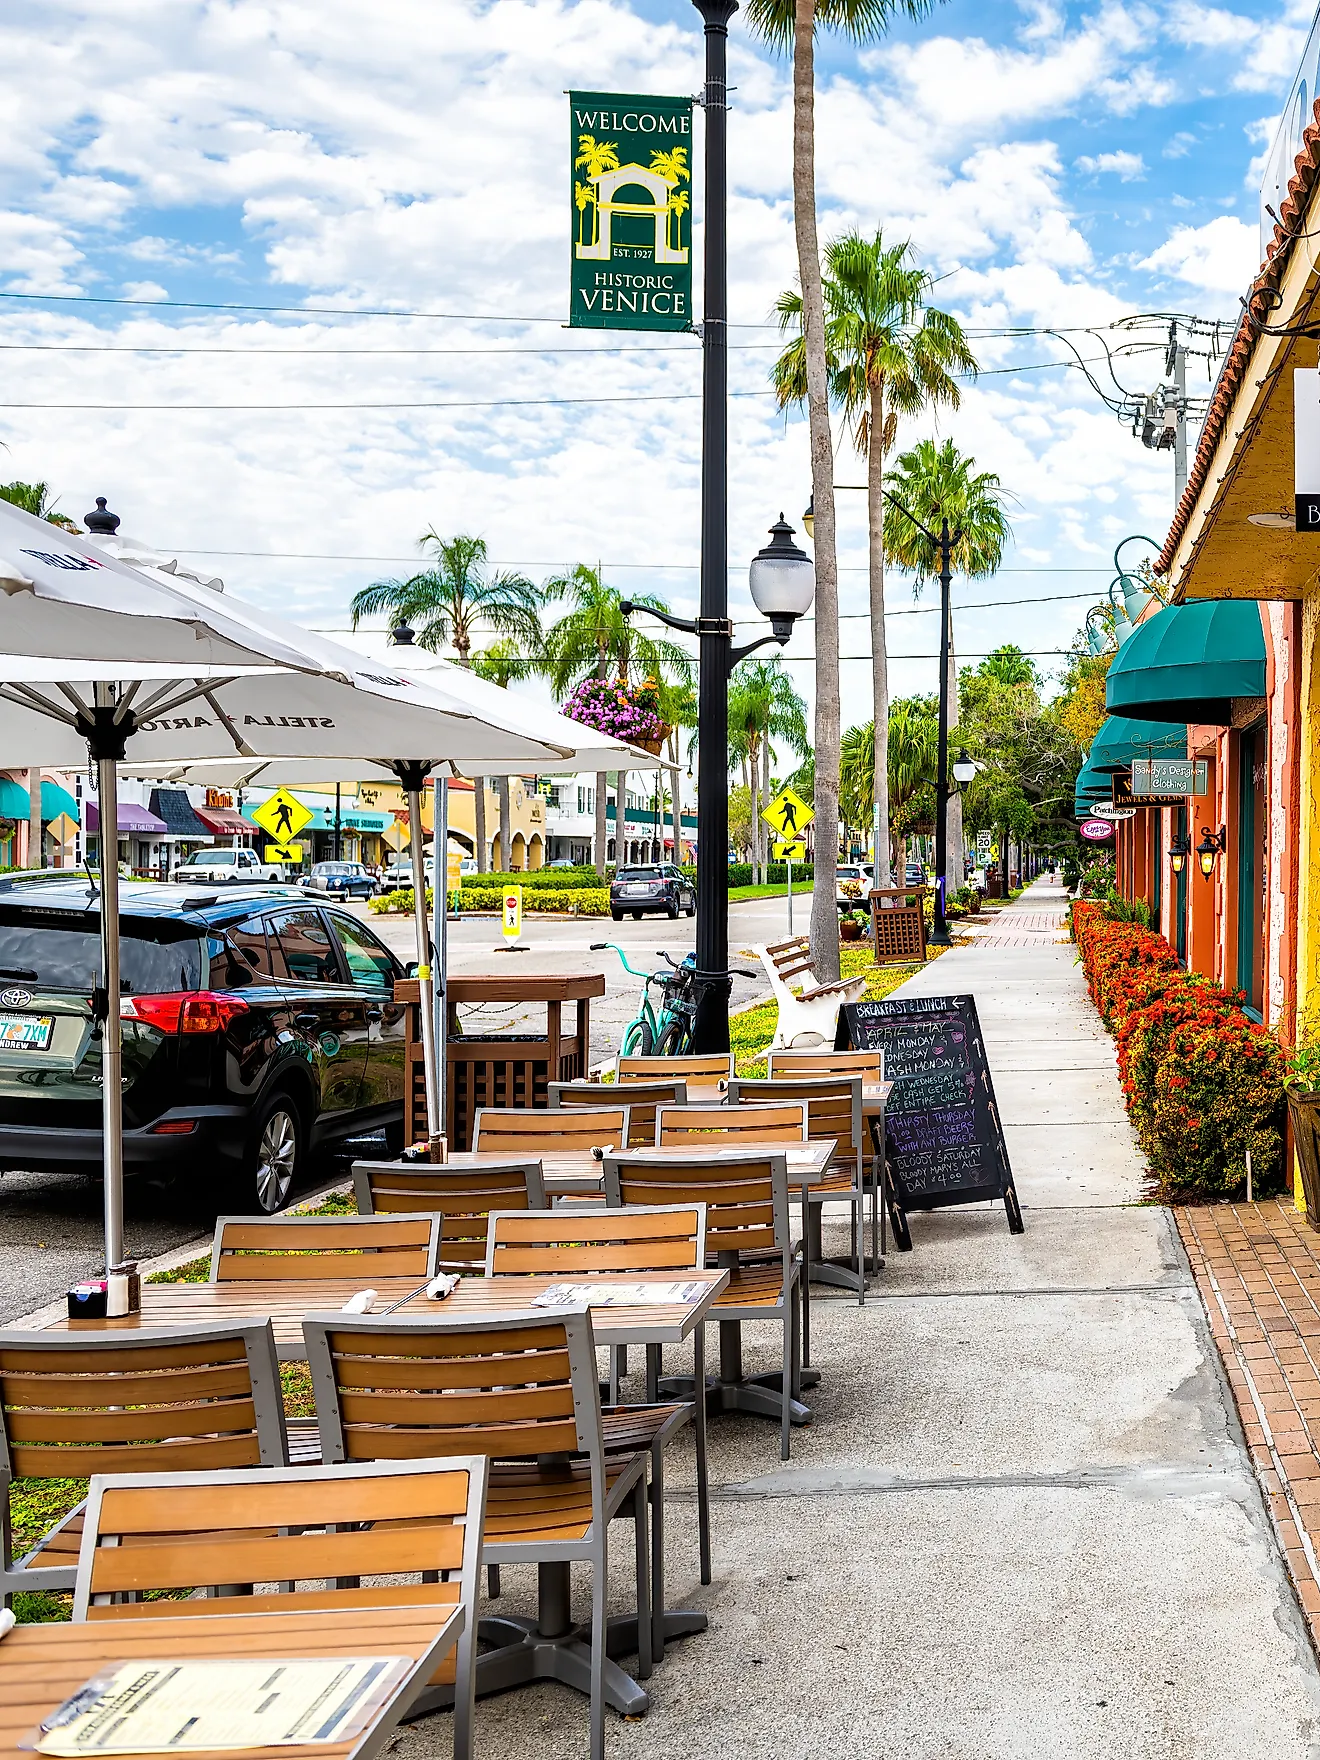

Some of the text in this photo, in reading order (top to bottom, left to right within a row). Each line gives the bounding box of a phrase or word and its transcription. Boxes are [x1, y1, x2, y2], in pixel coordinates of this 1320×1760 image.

[575, 110, 690, 134] WELCOME
[613, 248, 652, 259] EST. 1927
[594, 272, 673, 289] HISTORIC
[579, 288, 685, 315] VENICE
[1134, 763, 1205, 779] Sandy's Designer
[1152, 778, 1187, 791] Clothing
[856, 1000, 907, 1018] BREAKFAST
[915, 998, 947, 1012] LUNCH
[23, 1024, 48, 1042] 7XM
[866, 1026, 908, 1041] APRIL
[922, 1021, 947, 1034] MAY
[868, 1040, 893, 1053] EVERY
[897, 1034, 936, 1049] MONDAY
[885, 1047, 929, 1062] DNESDAY
[886, 1062, 912, 1076] ASH
[914, 1056, 955, 1073] MONDAY
[894, 1073, 954, 1091] SH WEDNESDAY
[886, 1089, 967, 1112] OFF ENTIRE CHECK
[903, 1087, 925, 1100] CASH
[927, 1085, 944, 1095] GET
[886, 1108, 976, 1131] THIRSTY THURSDAY
[916, 1126, 942, 1138] DRAFT
[943, 1120, 975, 1135] BEERS
[897, 1132, 977, 1153] WITH ANY BURGER
[897, 1147, 981, 1170] BLOODY SATURDAY
[899, 1167, 927, 1181] BLOODY
[961, 1159, 982, 1169] ALL
[906, 1177, 927, 1193] DAY
